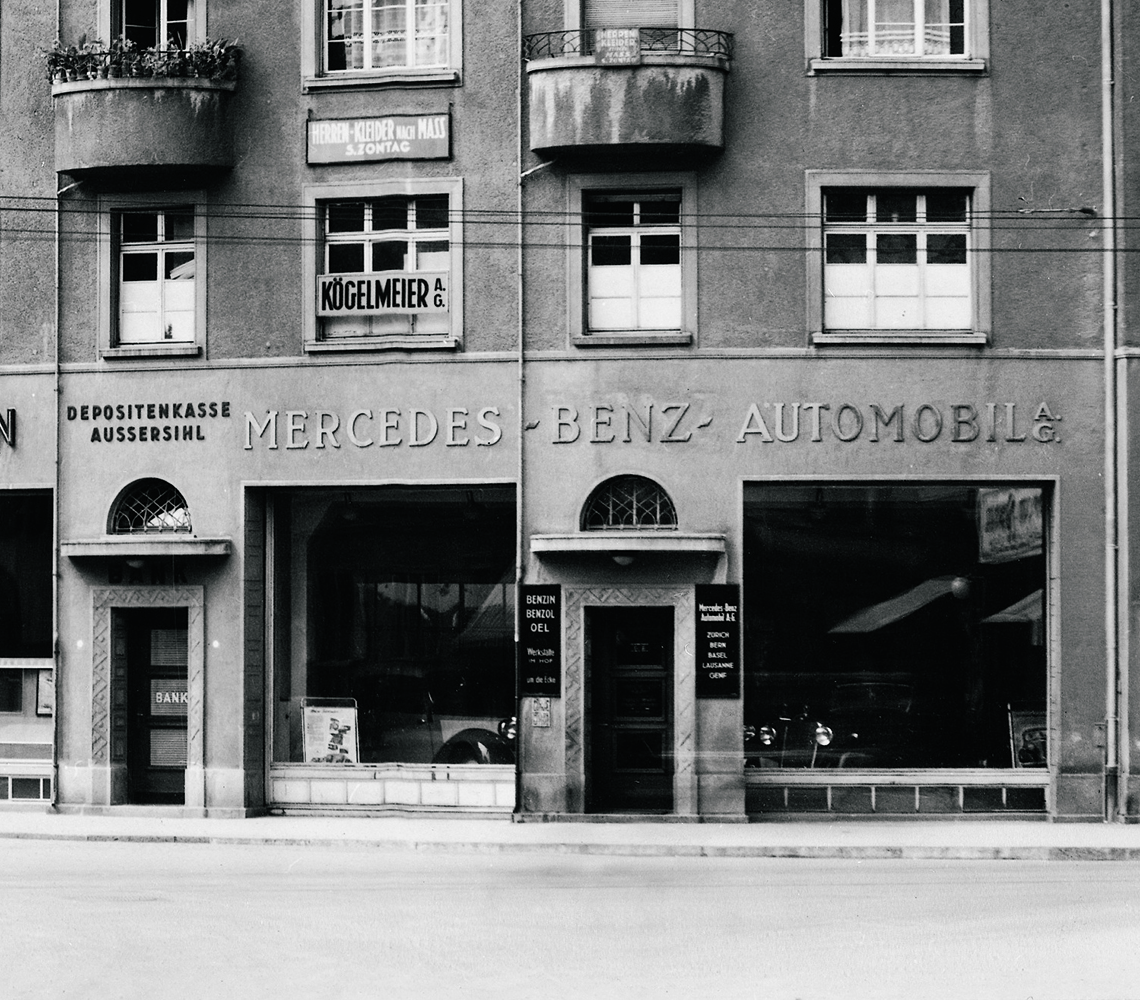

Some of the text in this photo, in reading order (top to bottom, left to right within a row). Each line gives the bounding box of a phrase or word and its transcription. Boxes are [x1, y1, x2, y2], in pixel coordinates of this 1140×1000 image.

[396, 125, 415, 140] NACH
[417, 117, 446, 140] MASS
[321, 277, 429, 311] KÖGELMEIER
[66, 401, 231, 421] DEPOSITENKASSE
[735, 401, 1027, 444] AUTOMOBIL
[90, 425, 205, 443] AUSSERSIHL
[526, 595, 556, 605] BENZIN
[526, 609, 555, 619] BENZOL
[530, 623, 550, 633] OEL
[155, 692, 188, 703] BANK
